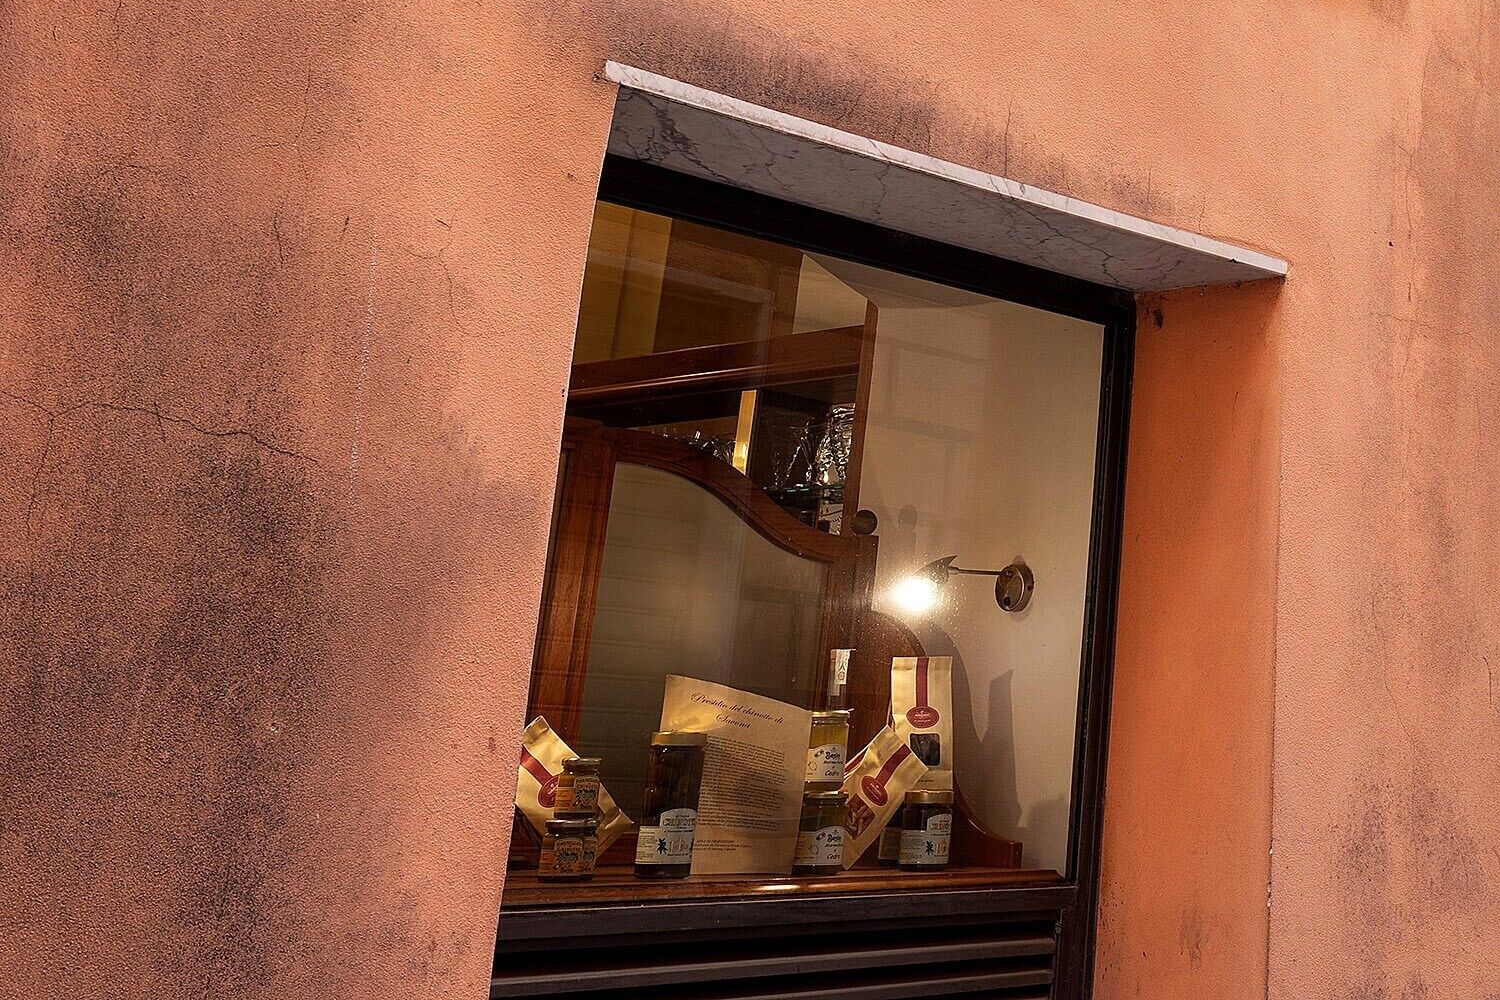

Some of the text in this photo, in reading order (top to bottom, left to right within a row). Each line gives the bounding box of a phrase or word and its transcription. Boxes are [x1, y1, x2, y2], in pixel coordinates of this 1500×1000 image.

[690, 693, 784, 724] Presidio del chinotto di
[716, 713, 751, 729] Savona
